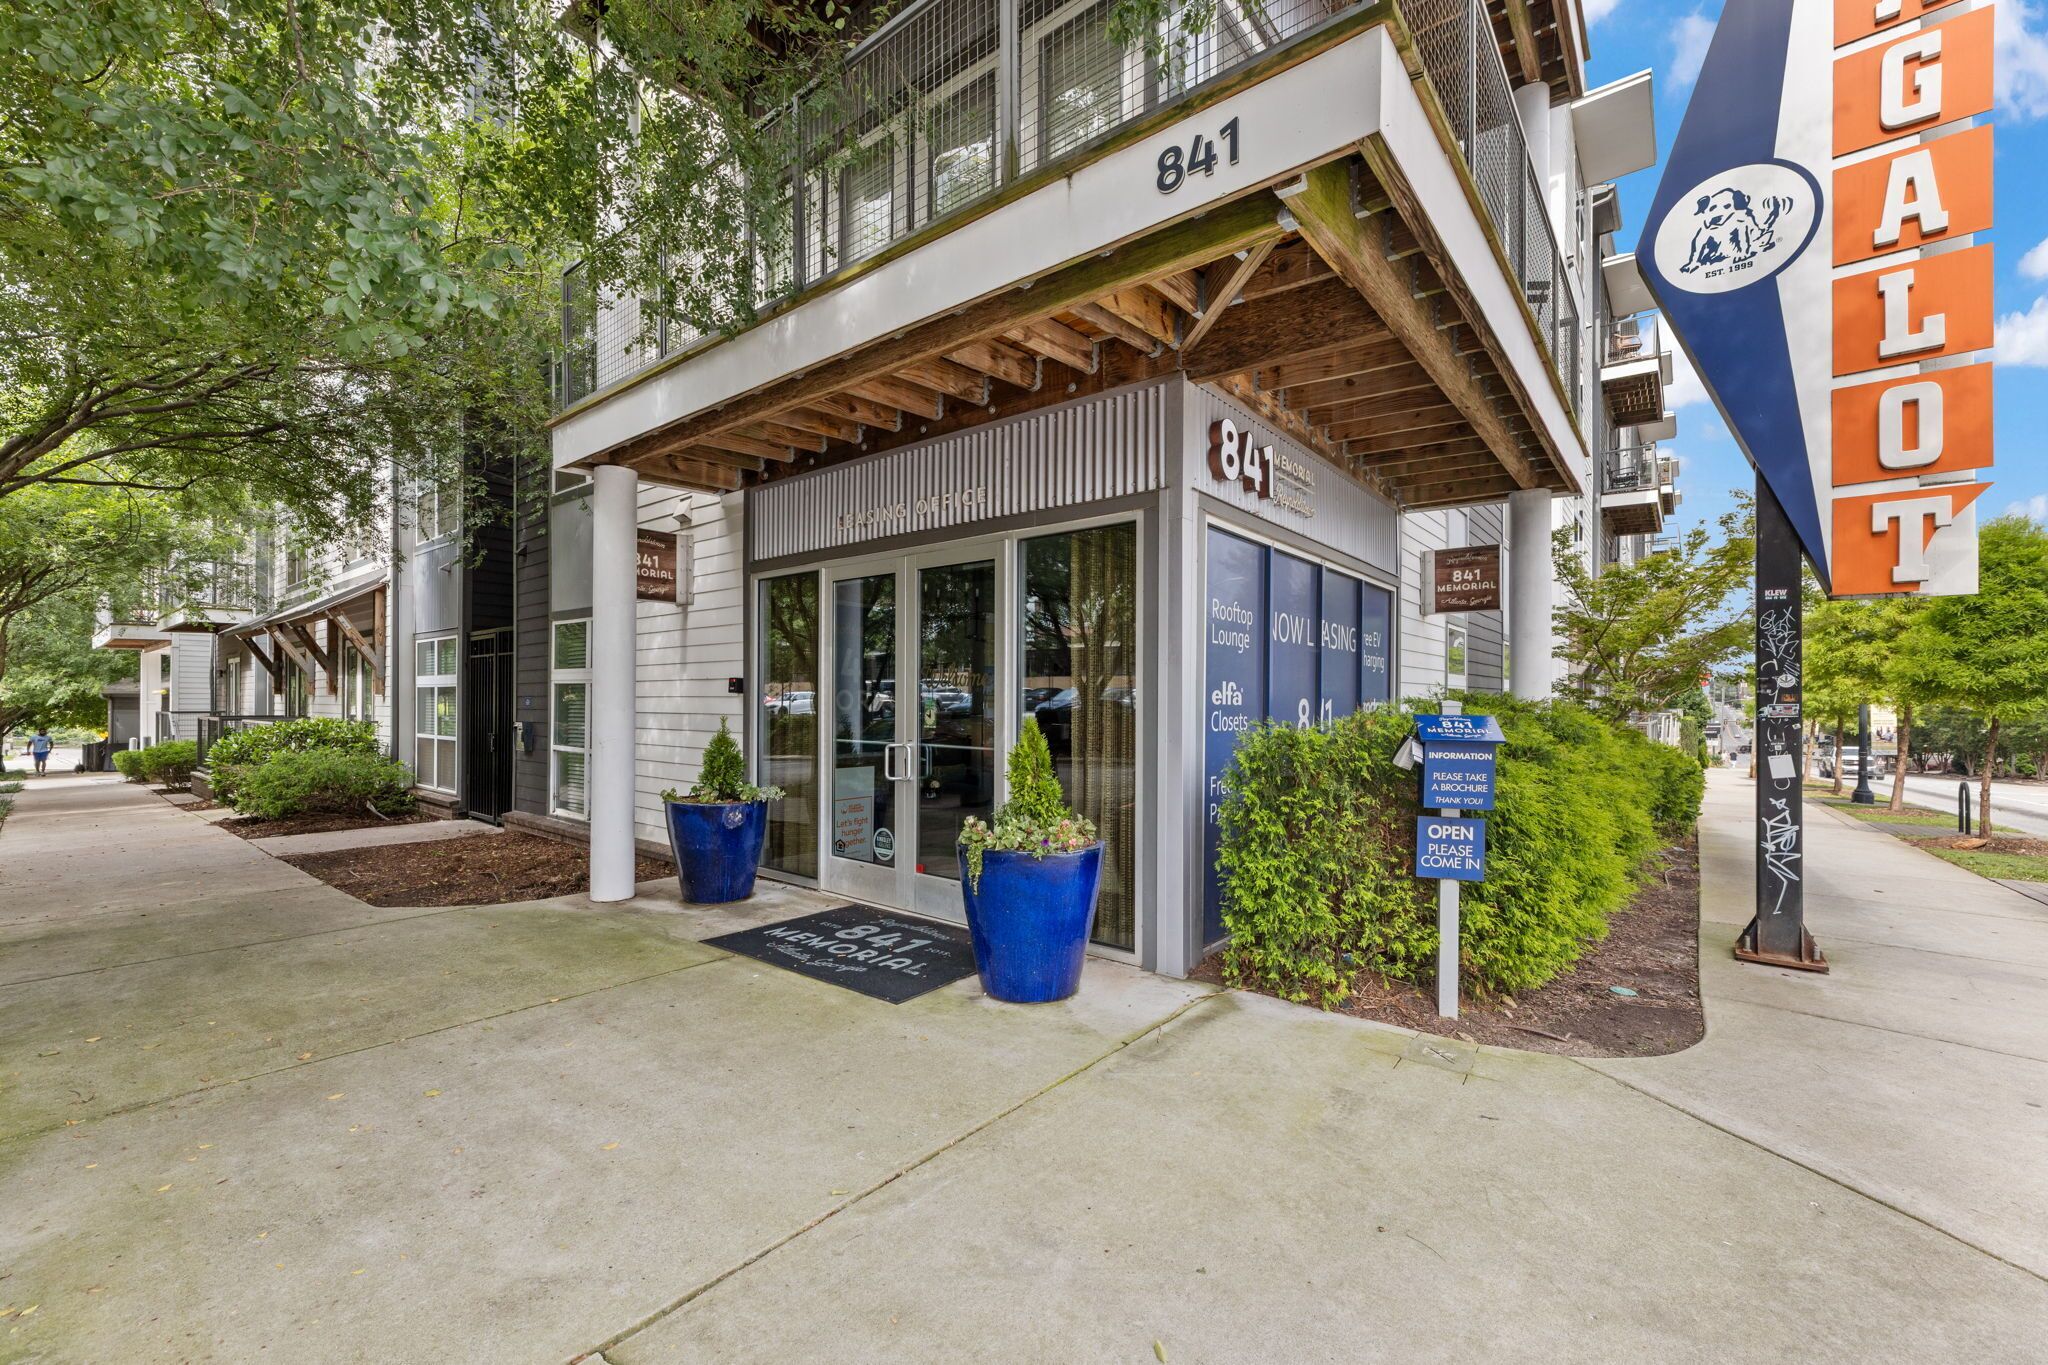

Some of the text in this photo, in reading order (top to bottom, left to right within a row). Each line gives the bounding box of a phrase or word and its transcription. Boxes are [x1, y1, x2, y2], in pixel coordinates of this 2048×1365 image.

[1156, 116, 1240, 194] 841
[1705, 260, 1753, 279] EST. 1999
[1872, 0, 1952, 584] GALOT
[1212, 418, 1274, 500] 841
[1273, 451, 1315, 486] MEMORIAL
[837, 486, 986, 530] LEASING OFFICE
[637, 568, 674, 580] ORIAL
[1452, 568, 1481, 582] 841
[1437, 580, 1497, 593] MEMORIAL
[1764, 589, 1788, 597] KLEW
[1212, 598, 1253, 631] Rooftop
[1211, 623, 1250, 654] Lounge
[1373, 631, 1382, 648] EV
[1363, 649, 1385, 673] harging
[1211, 680, 1243, 706] elfa
[1211, 709, 1248, 732] Closets
[1442, 720, 1473, 729] 841
[1427, 727, 1494, 735] MEMORIAL
[1428, 751, 1493, 761] INFORMATION
[1433, 772, 1488, 782] PLEASE TAKE
[1431, 783, 1489, 793] A BROCHURE
[1435, 796, 1484, 805] THANK YOU!
[1427, 824, 1474, 841] OPEN
[1428, 843, 1474, 858] PLEASE
[1420, 855, 1480, 870] COME IN
[834, 924, 933, 953] 841
[763, 926, 929, 976] MEMORIAL
